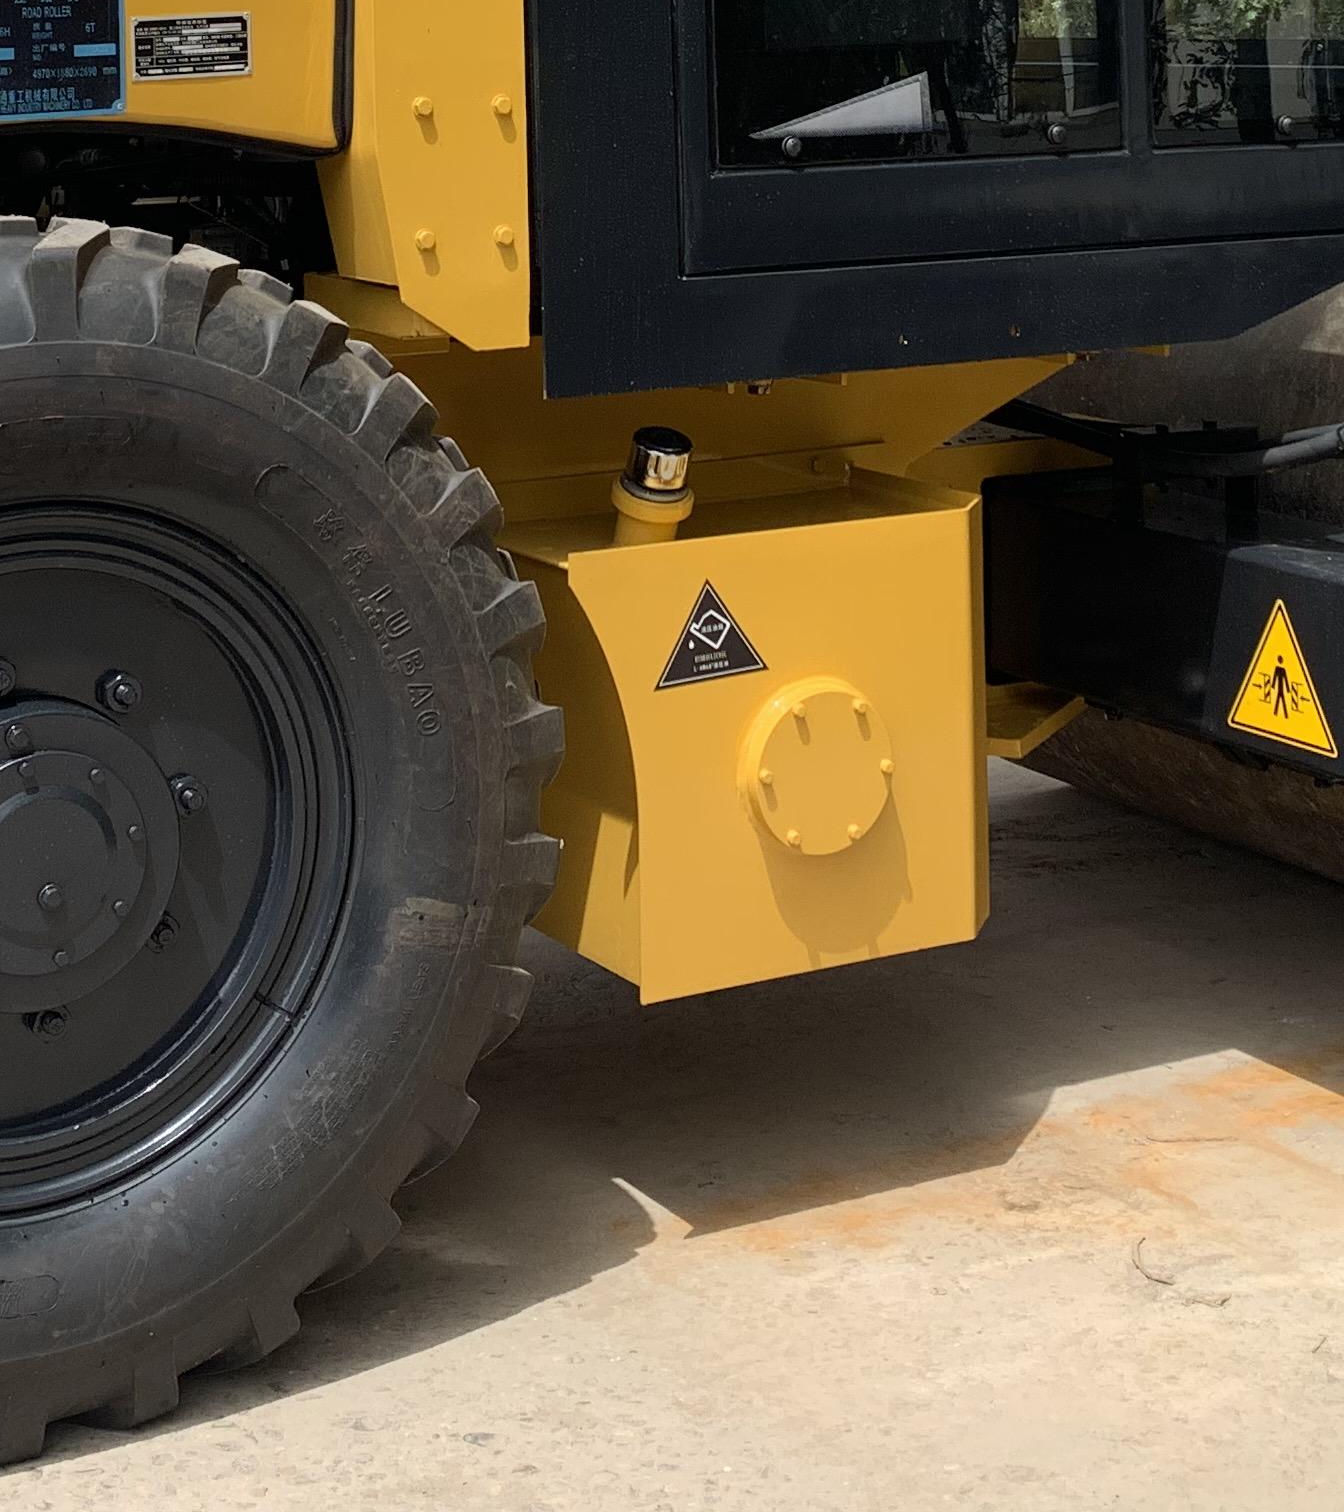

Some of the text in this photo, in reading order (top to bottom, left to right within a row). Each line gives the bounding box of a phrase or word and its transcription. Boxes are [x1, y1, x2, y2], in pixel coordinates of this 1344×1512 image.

[22, 5, 72, 19] ROAD ROLLER
[85, 22, 96, 33] 6T
[367, 584, 442, 736] LUBAO
